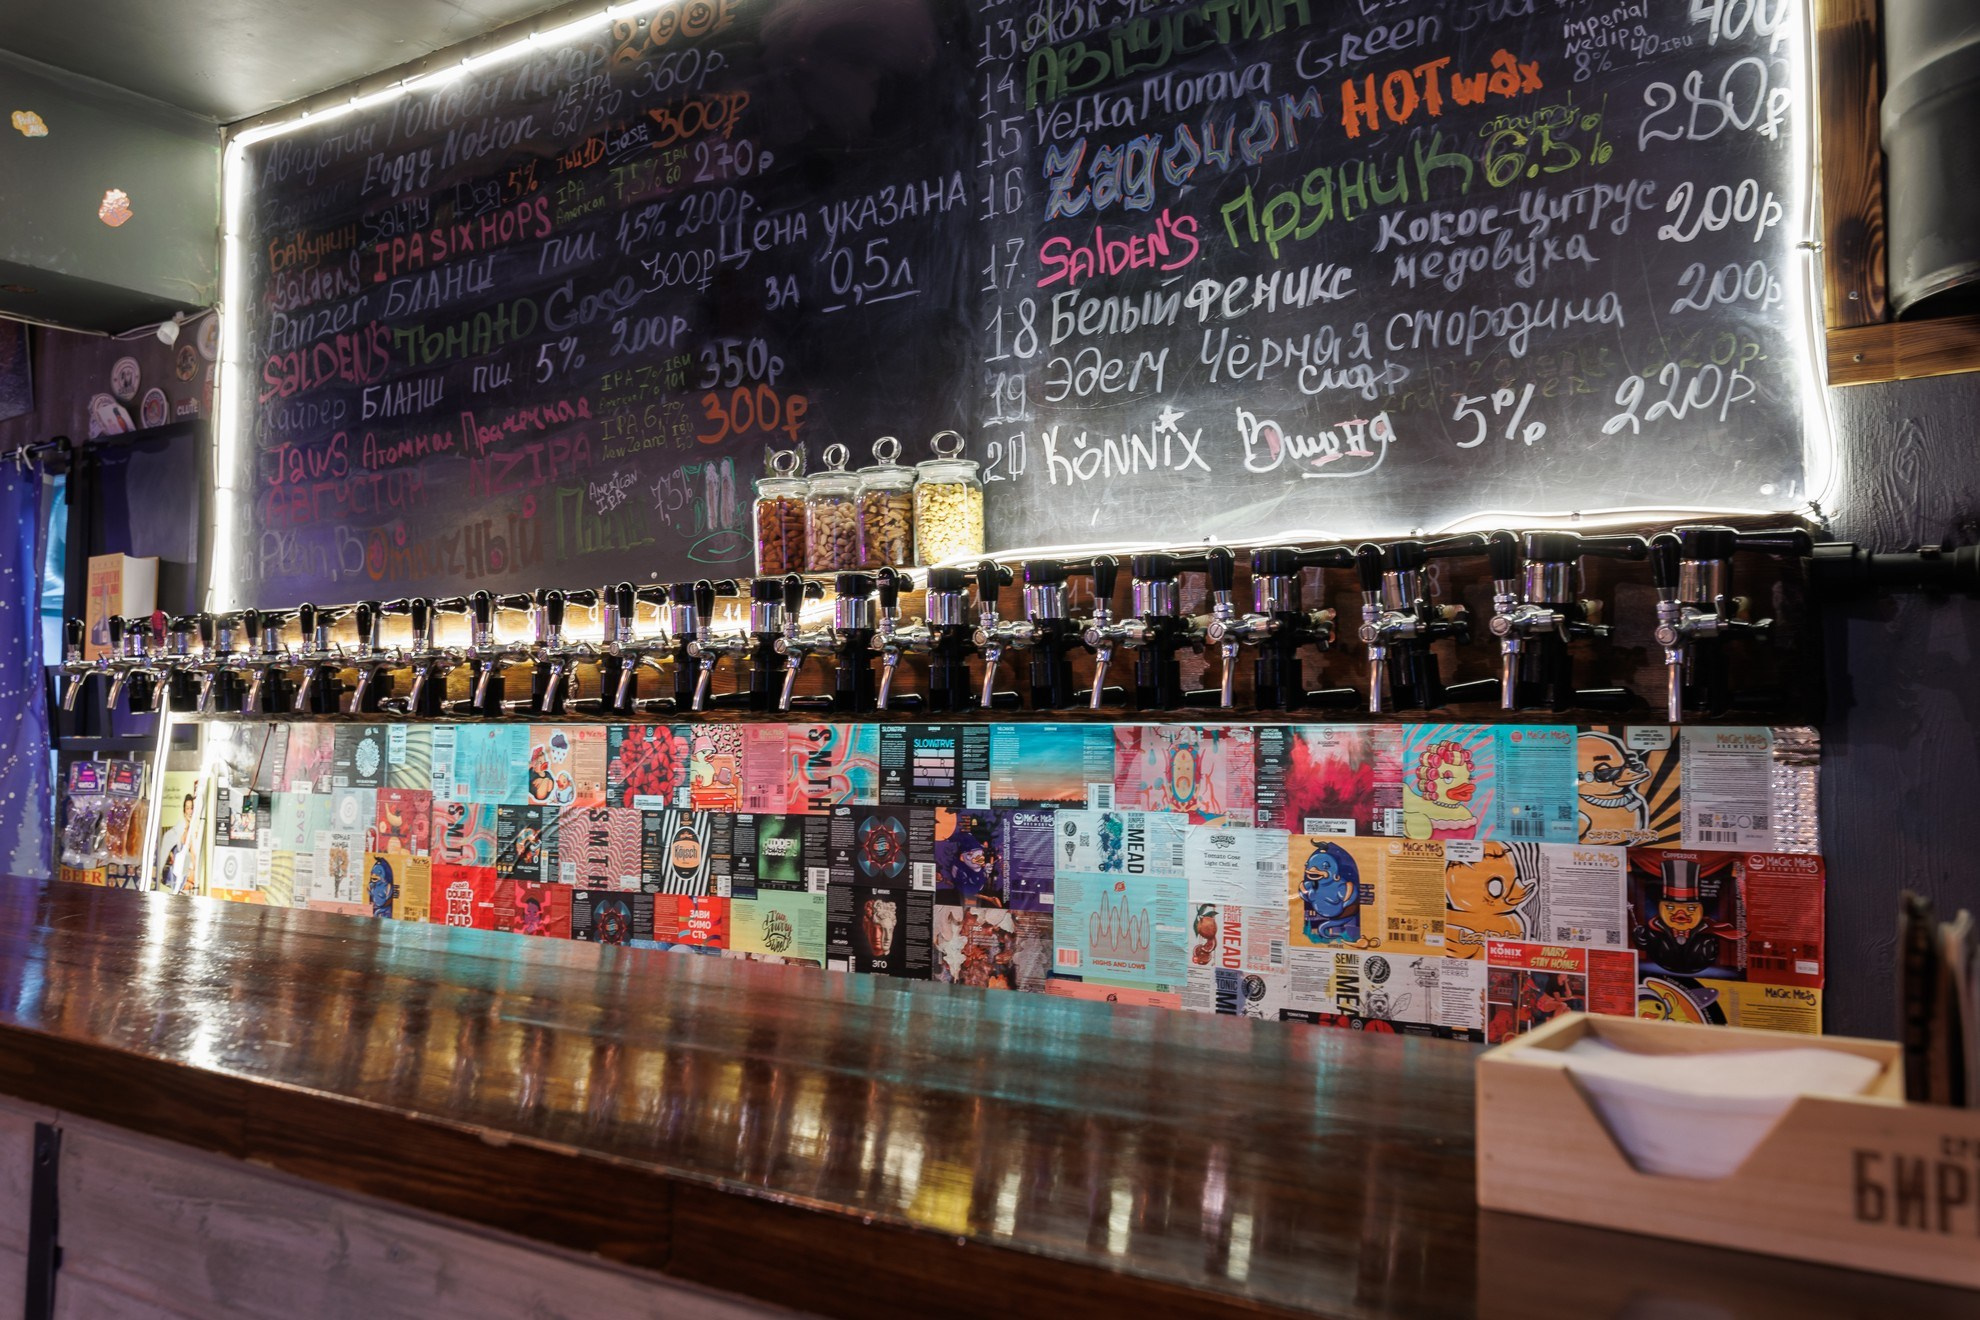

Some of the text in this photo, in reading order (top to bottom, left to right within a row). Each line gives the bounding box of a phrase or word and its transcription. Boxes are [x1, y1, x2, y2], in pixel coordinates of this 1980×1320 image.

[976, 19, 1016, 67] 13
[1574, 35, 1693, 82] 8% 40 IBU
[979, 63, 1017, 119] 14
[1140, 62, 1271, 119] Morava
[1341, 56, 1450, 139] HOT
[977, 116, 1024, 168] 15
[666, 164, 681, 184] 60
[980, 167, 1025, 220] 16
[374, 197, 552, 283] IPA SIX HOPS
[384, 254, 497, 317] БЛАНШ
[268, 295, 367, 352] Panzer
[362, 377, 444, 420] БЛАНШ
[536, 337, 585, 383] 5%
[601, 372, 632, 392] IPA
[664, 353, 691, 371] IBU
[1452, 383, 1548, 450] 5%
[983, 431, 1026, 484] 20
[598, 490, 627, 515] IPA
[1128, 829, 1145, 874] MEAD
[61, 868, 104, 885] BEER
[450, 900, 469, 915] BIG
[687, 919, 711, 929] СИМО
[689, 909, 710, 919] ЗАВИ
[691, 929, 708, 939] СТЬ
[1223, 922, 1242, 969] MEAD
[872, 960, 888, 969] ЭГО
[1128, 962, 1146, 970] LOWS
[1530, 957, 1550, 966] STAY
[1853, 1149, 1980, 1238] БИР
